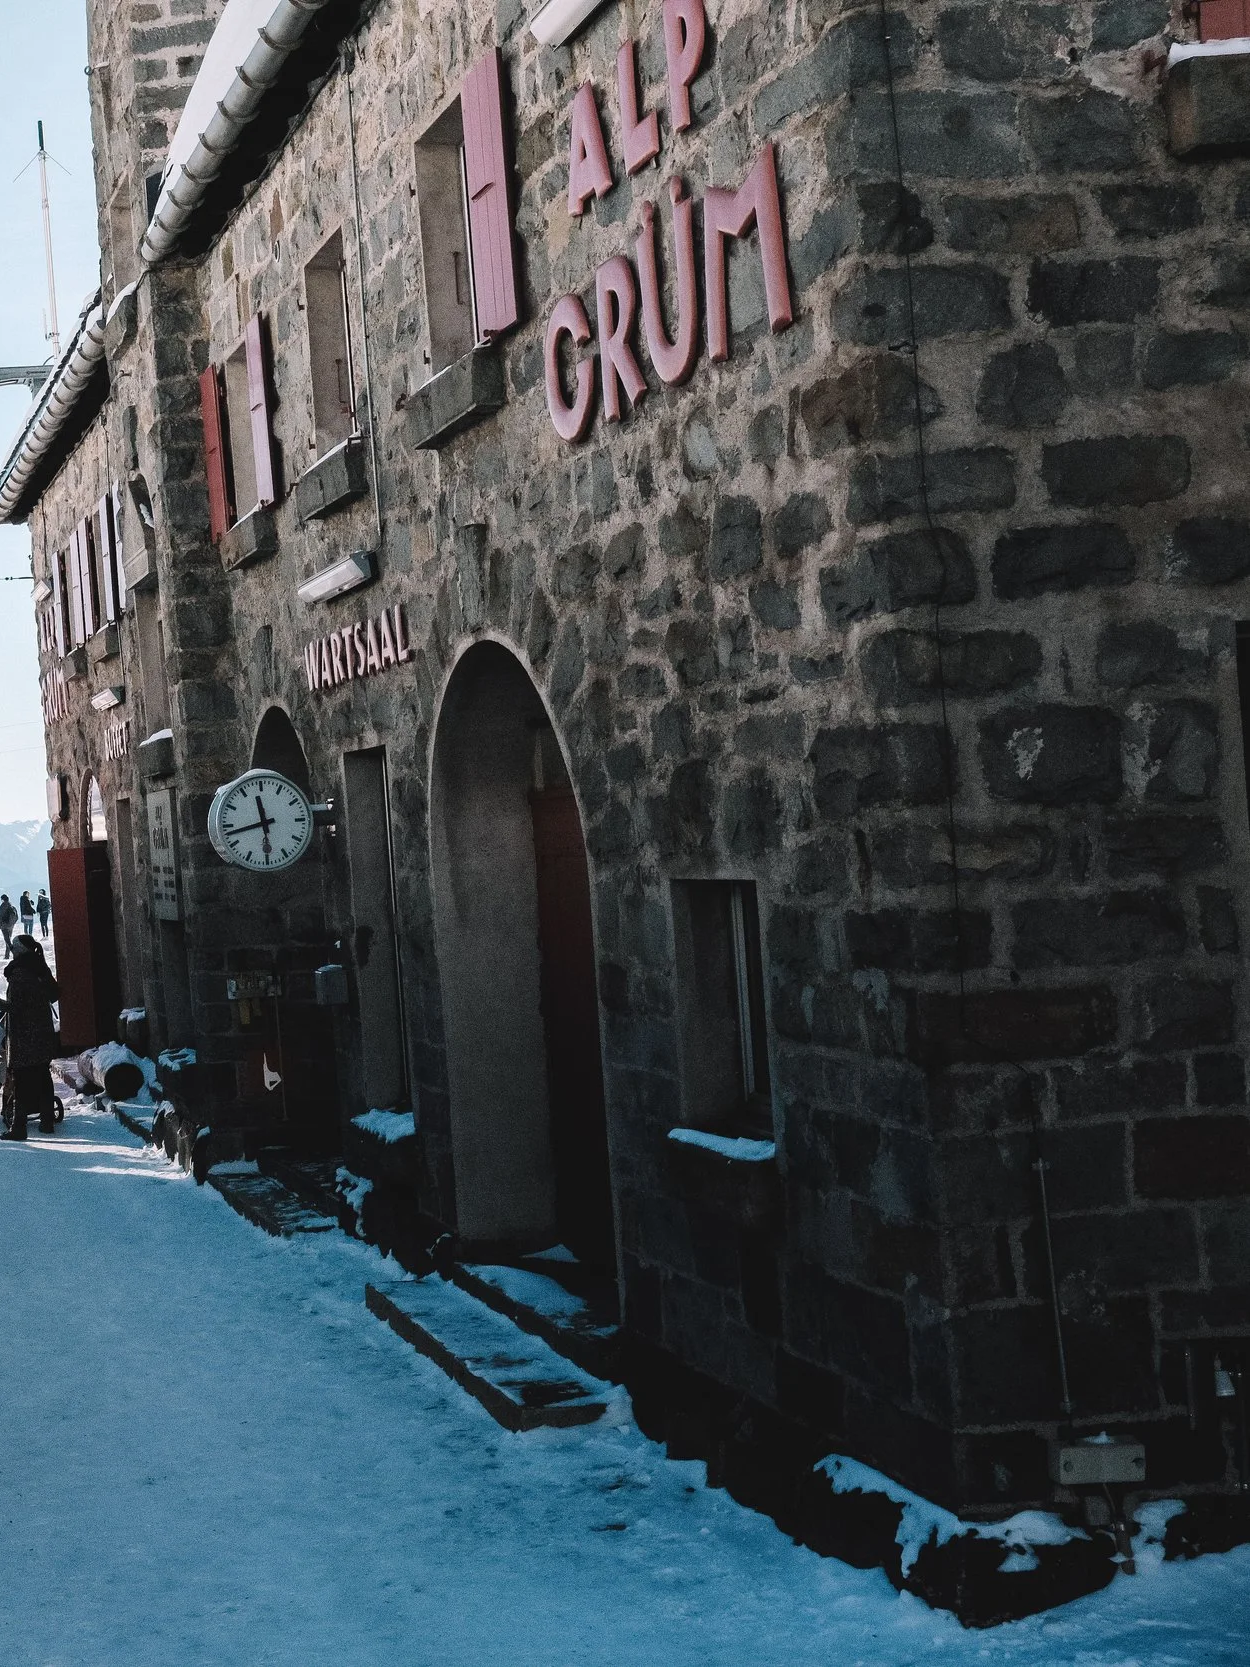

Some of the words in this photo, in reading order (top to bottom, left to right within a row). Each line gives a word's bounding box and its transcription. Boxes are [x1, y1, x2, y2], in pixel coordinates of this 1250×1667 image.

[567, 0, 706, 217] ALP
[545, 138, 793, 444] GRÜM
[304, 603, 410, 691] WARTSAAL
